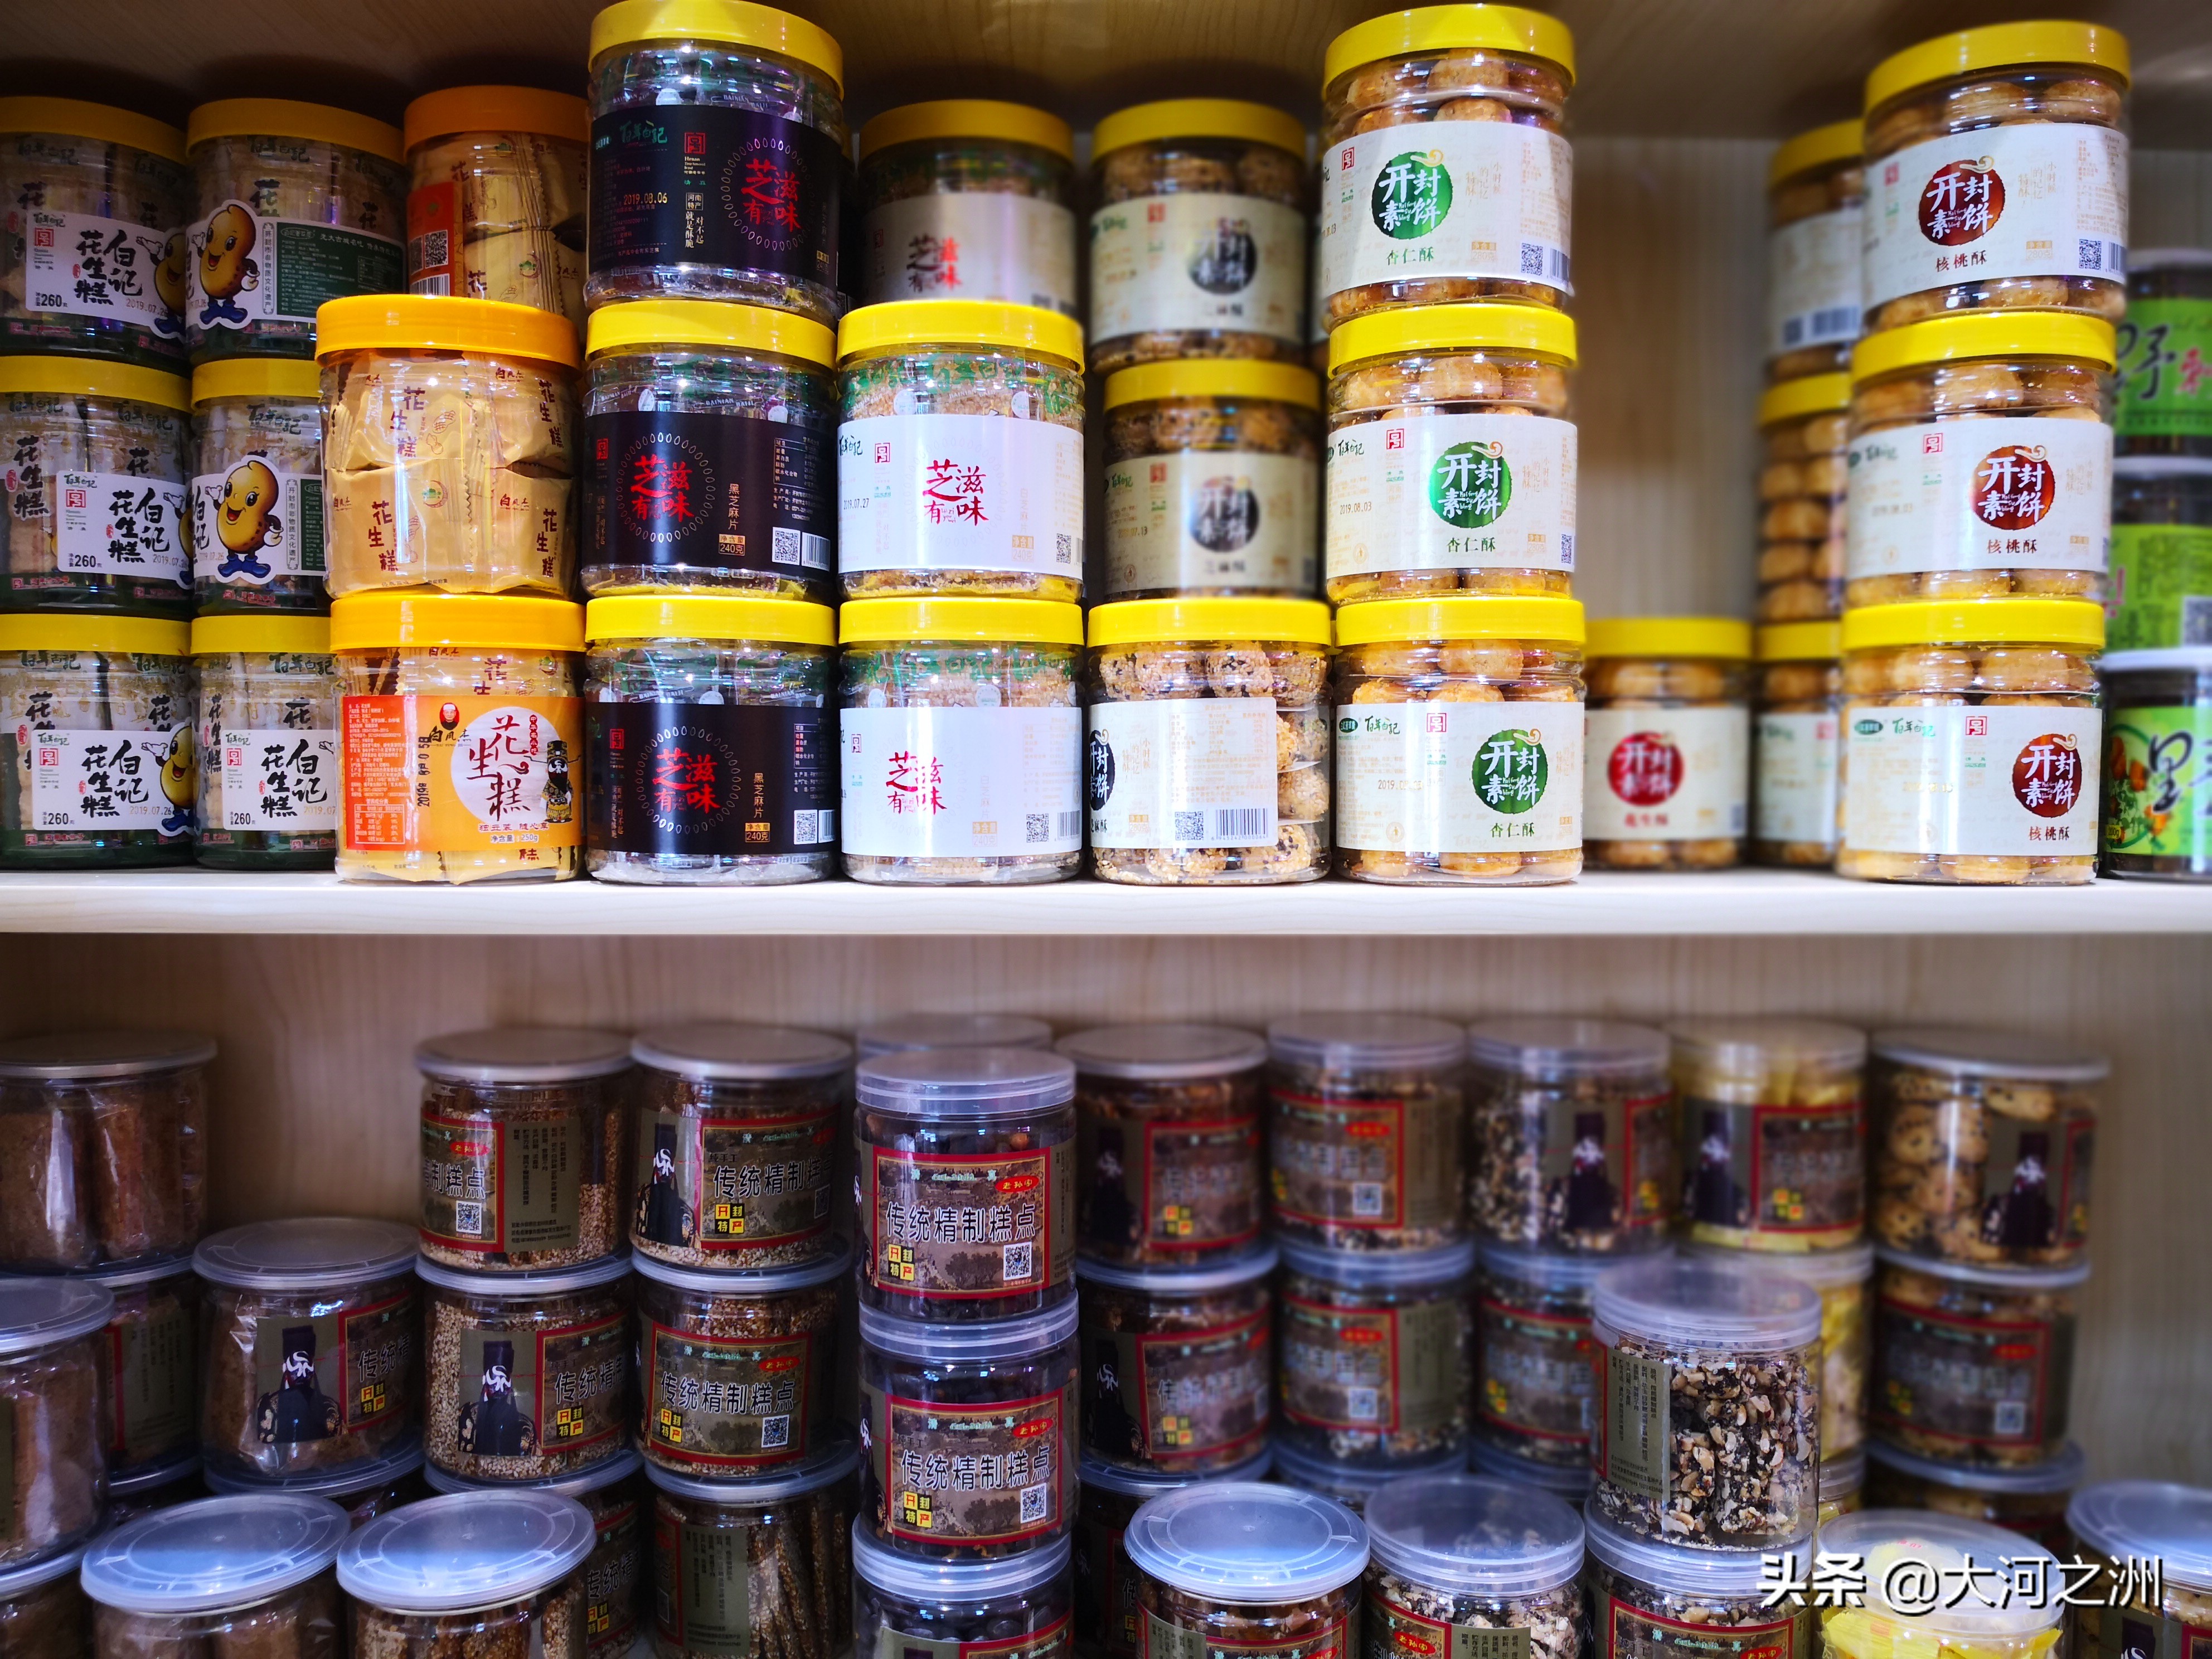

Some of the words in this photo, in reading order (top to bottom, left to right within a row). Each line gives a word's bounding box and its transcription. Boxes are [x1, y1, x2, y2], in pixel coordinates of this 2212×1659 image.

[624, 192, 668, 205] 2019.08.06
[1379, 164, 1441, 202] 开封
[1927, 172, 1993, 212] 开封
[696, 216, 704, 244] 对不起
[1379, 197, 1442, 231] 素饼
[1927, 203, 1993, 239] 素饼
[74, 230, 113, 305] 花生糕
[103, 229, 143, 296] 白记
[1387, 246, 1434, 266] 杏仁酥
[1936, 250, 1987, 272] 核桃酥
[13, 435, 50, 520] 花生糕
[1438, 453, 1501, 493] 开封
[1977, 456, 2045, 493] 开封
[134, 487, 170, 552] 白记
[728, 483, 740, 530] 黑芝麻片
[843, 498, 869, 510] 2019.07.27
[1340, 501, 1371, 515] 2019.08.03
[1438, 488, 1502, 521] 素饼
[1978, 491, 2044, 522] 素饼
[108, 490, 145, 563] 花生糕
[368, 501, 399, 571] 花生糕
[536, 508, 558, 578] 花生糕
[1446, 537, 1496, 552] 杏仁酥
[720, 545, 744, 555] 240克
[1987, 539, 2038, 554] 核桃酥
[109, 740, 149, 803] 白记
[286, 739, 328, 803] 白记
[467, 715, 530, 821] 花生糕
[1481, 740, 1540, 777] 开封
[2021, 745, 2075, 782] 开封
[81, 745, 120, 818] 花生糕
[261, 744, 297, 818] 花生糕
[754, 773, 764, 818] 黑芝麻片
[1481, 774, 1540, 805] 素饼
[2021, 779, 2075, 810] 素饼
[129, 806, 172, 816] 2019.07.26
[973, 822, 997, 834] 净含量
[746, 832, 769, 841] 240克
[1490, 823, 1535, 838] 杏仁酥
[2029, 826, 2070, 841] 核桃酥
[713, 1152, 833, 1198] 传统精制糕
[886, 1201, 1036, 1243] 传统精制糕点
[661, 1372, 796, 1415] 传统精制糕点
[901, 1446, 1051, 1492] 传统精制糕点
